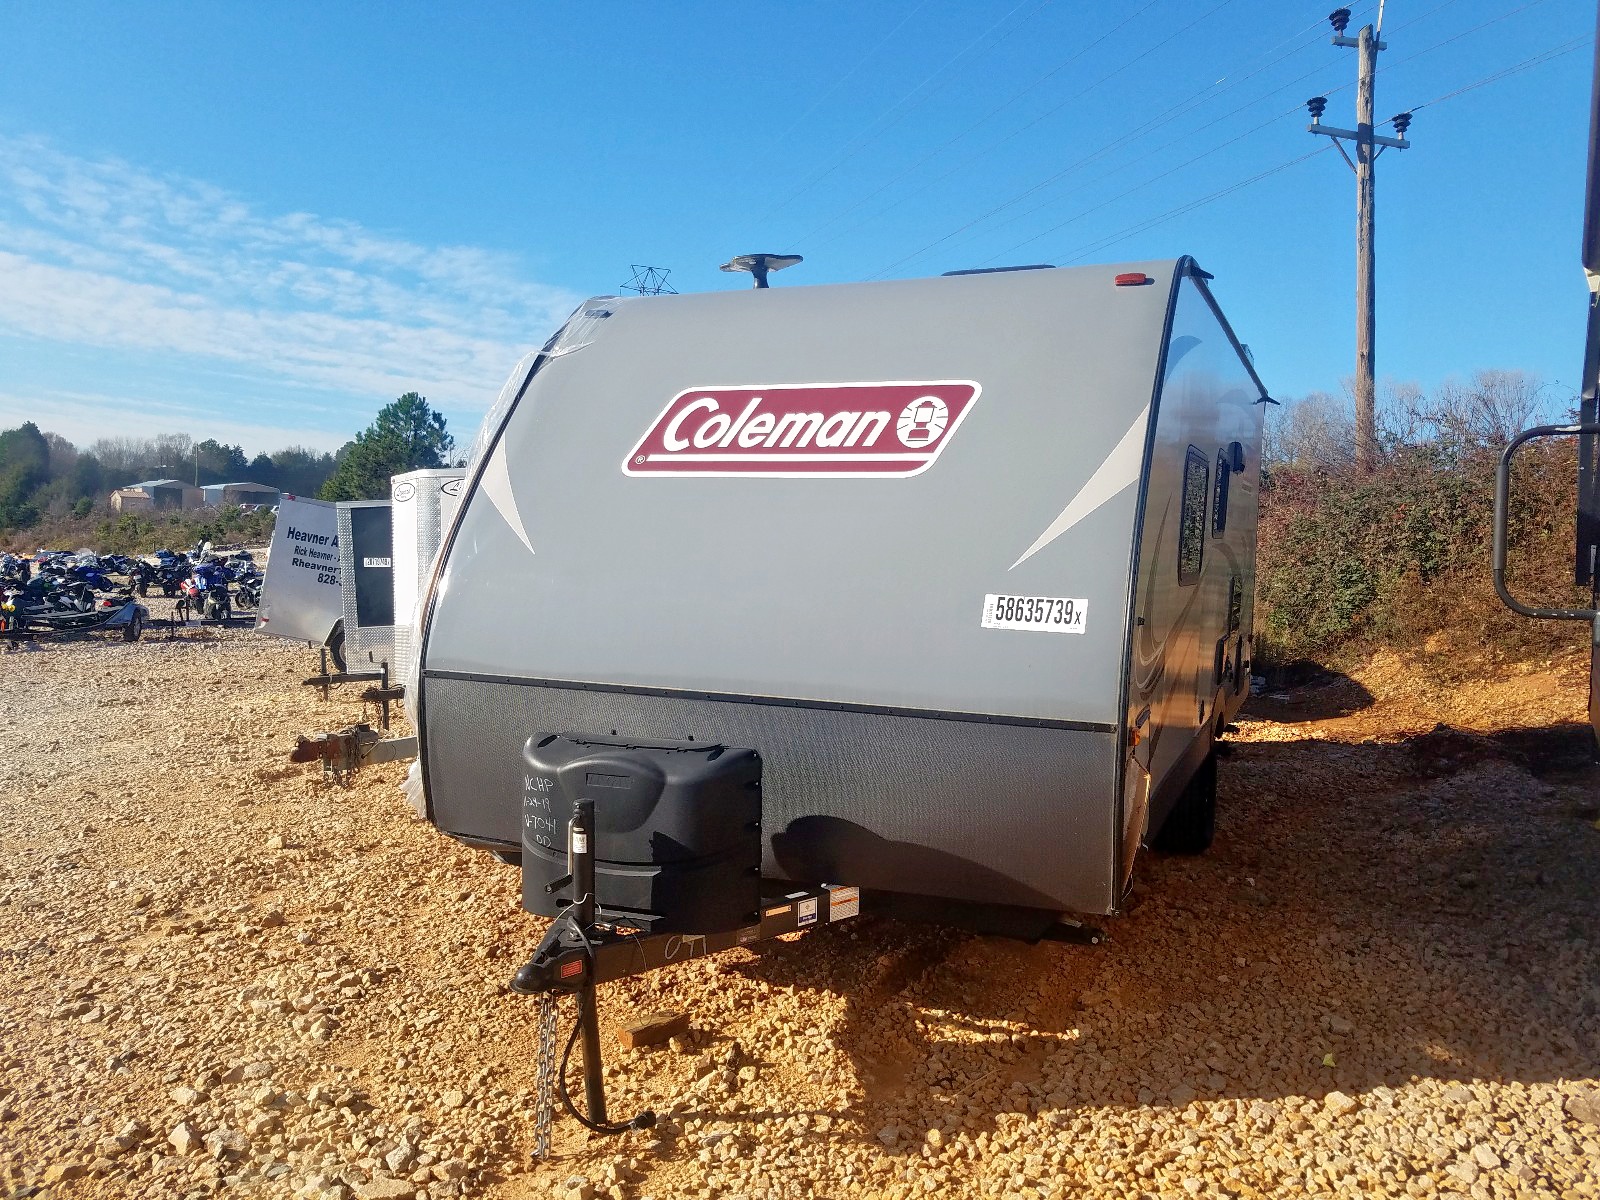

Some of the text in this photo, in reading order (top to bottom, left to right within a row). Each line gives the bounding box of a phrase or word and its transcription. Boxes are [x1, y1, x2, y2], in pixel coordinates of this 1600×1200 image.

[663, 397, 891, 452] Coleman
[286, 526, 330, 546] Heavner
[294, 545, 308, 557] Rick
[524, 774, 554, 792] NCHP
